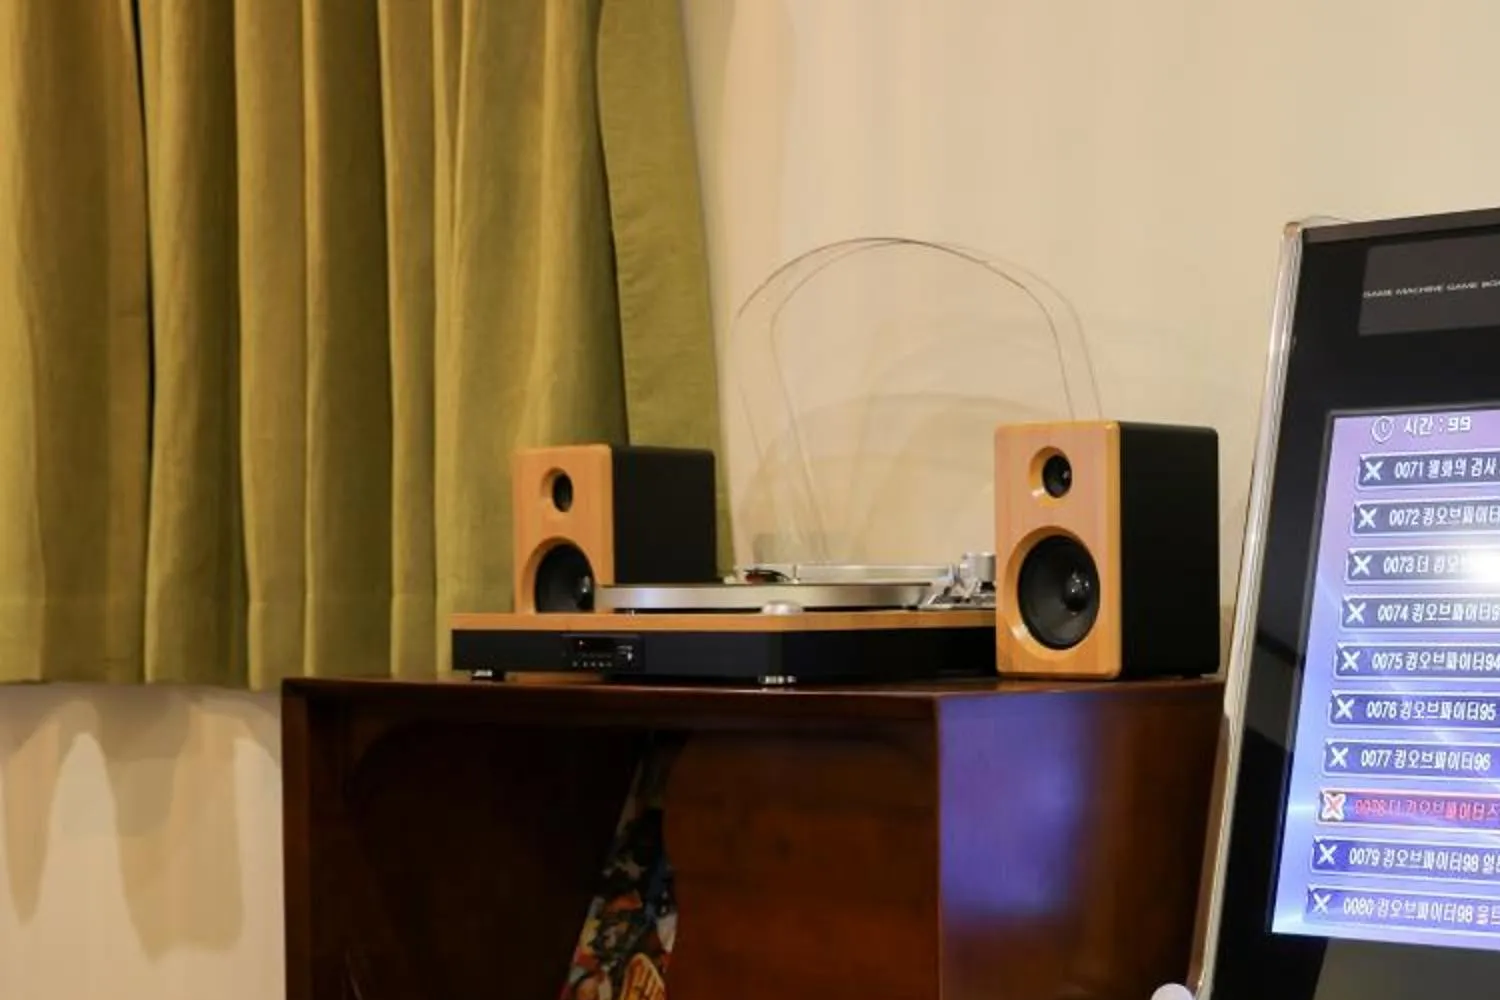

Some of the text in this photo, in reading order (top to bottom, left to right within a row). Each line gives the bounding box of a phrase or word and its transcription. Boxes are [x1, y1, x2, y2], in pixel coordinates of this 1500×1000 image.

[1447, 416, 1472, 432] 99
[1395, 461, 1424, 478] 0071
[1389, 509, 1419, 527] 0072
[1383, 555, 1412, 573] 0073
[1377, 604, 1408, 622] 0074
[1372, 652, 1402, 670] 0075
[1367, 701, 1397, 719] 0076
[1361, 749, 1392, 768] 0077
[1349, 847, 1379, 866] 0079
[1343, 898, 1374, 916] 0080
